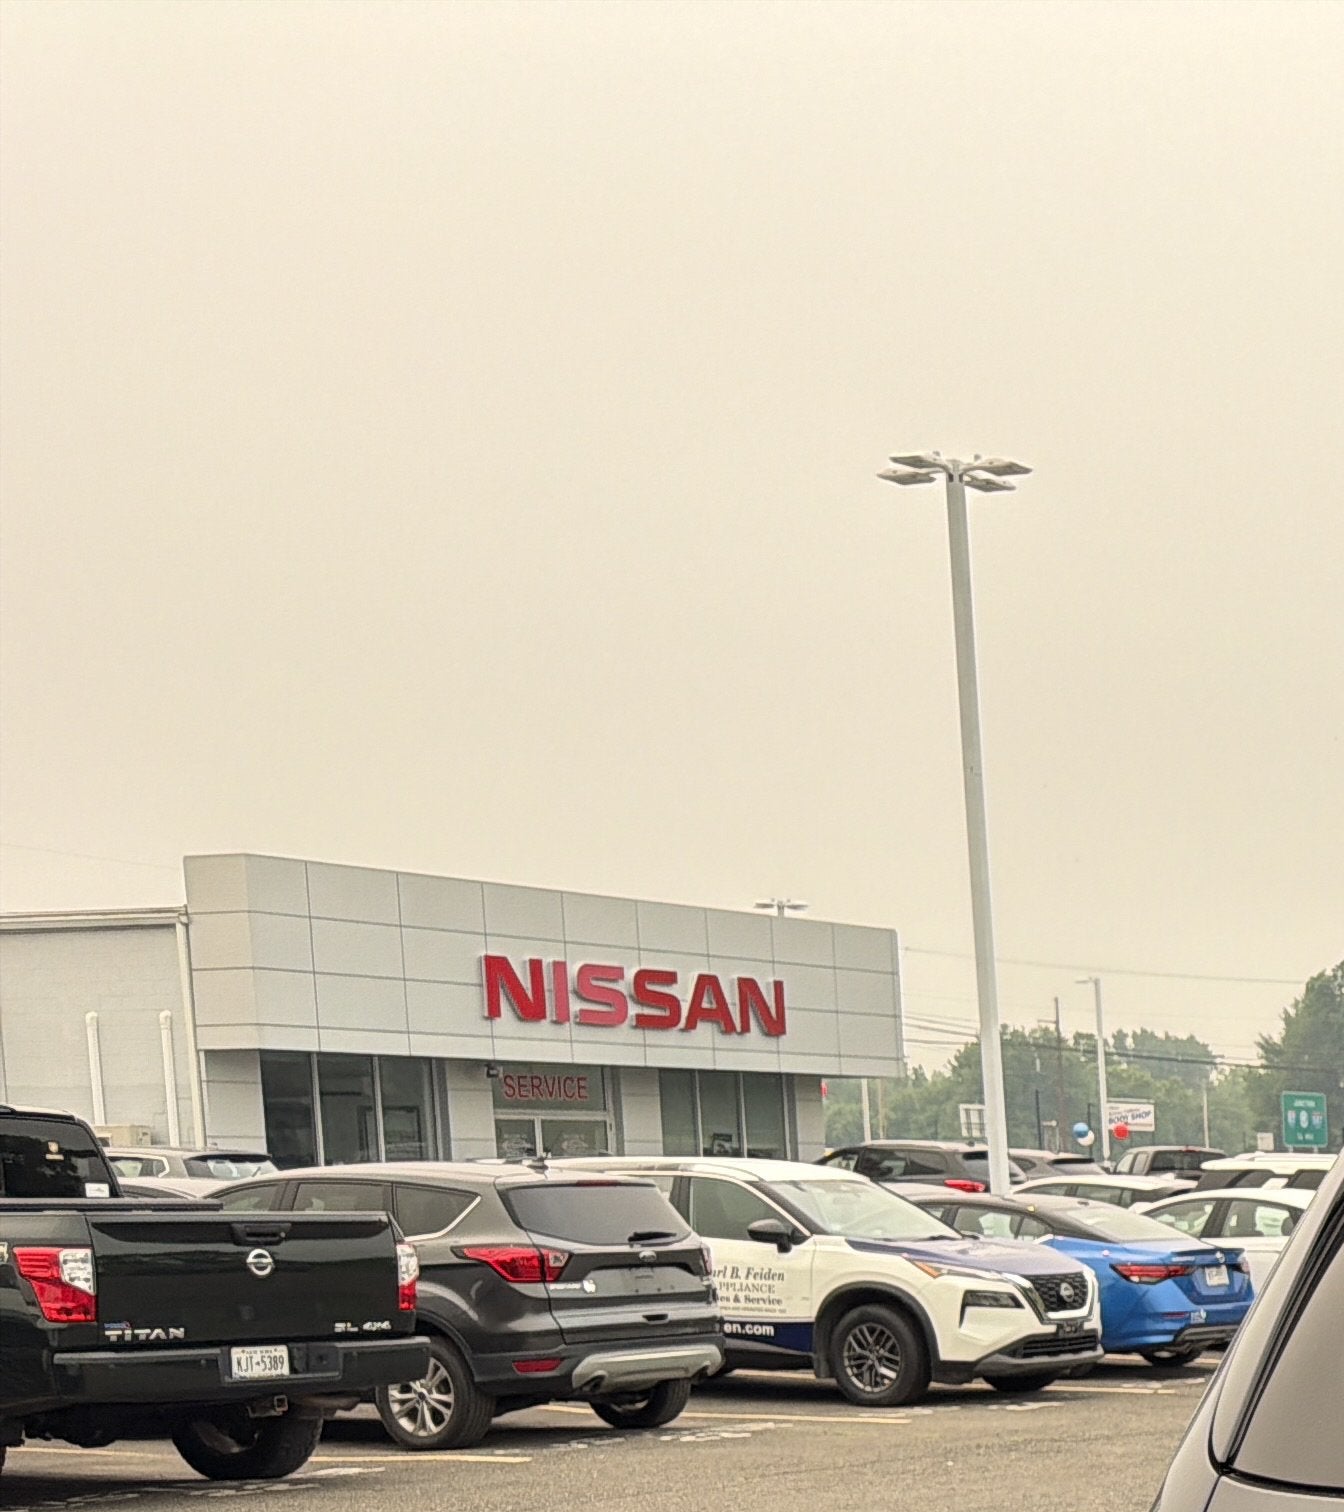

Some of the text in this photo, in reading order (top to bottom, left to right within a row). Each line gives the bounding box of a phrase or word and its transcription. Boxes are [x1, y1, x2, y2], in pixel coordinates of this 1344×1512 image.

[483, 953, 787, 1037] NISSAN
[503, 1074, 588, 1099] SERVICE
[745, 1266, 785, 1282] Feiden
[718, 1281, 776, 1294] PPLIANCE
[743, 1294, 783, 1306] Service
[104, 1327, 185, 1341] TITAN
